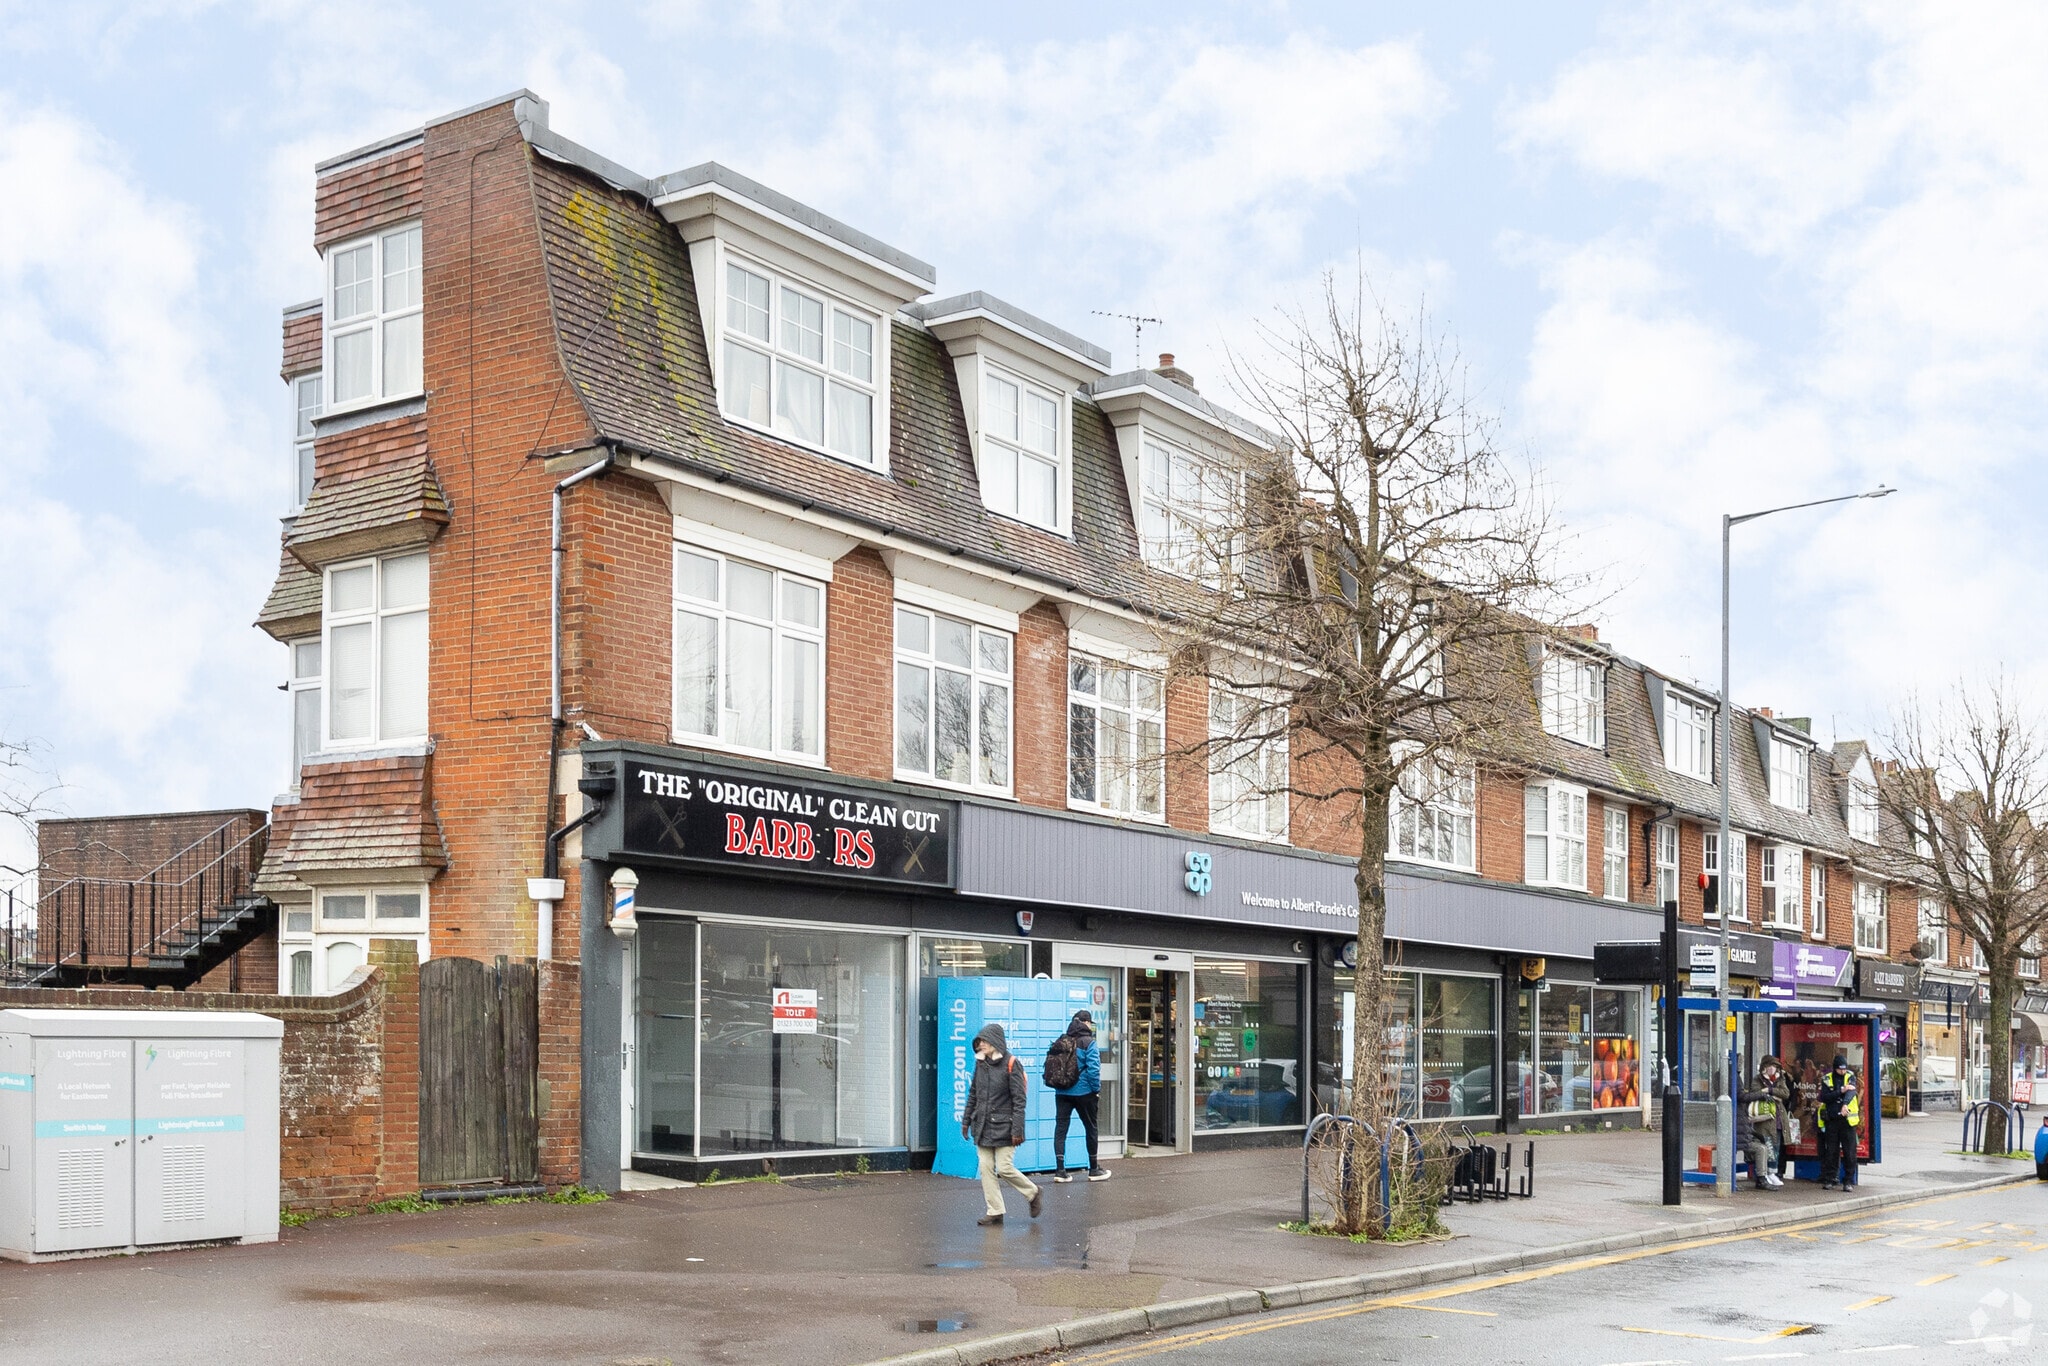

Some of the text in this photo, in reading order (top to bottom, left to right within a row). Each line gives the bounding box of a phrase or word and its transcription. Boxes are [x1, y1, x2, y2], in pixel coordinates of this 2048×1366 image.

[638, 769, 940, 834] THE "ORIGINAL" CLEAN CUT
[725, 813, 876, 869] BARBRS
[1241, 890, 1280, 910] Welcome
[1281, 898, 1290, 910] to
[1291, 897, 1315, 914] Albert
[1315, 900, 1347, 918] Parade's
[1730, 947, 1757, 964] GAMBLE
[785, 1008, 806, 1017] TO LET
[950, 998, 967, 1041] hub
[1816, 1031, 1841, 1039] Intrepid
[57, 1048, 127, 1060] Lightning Fibre
[167, 1047, 232, 1060] Lightning Fibre
[63, 1082, 82, 1090] Local
[82, 1082, 112, 1090] Network
[953, 1045, 967, 1122] amazon
[1793, 1082, 1817, 1090] Make
[60, 1092, 108, 1100] for Eastbourne
[63, 1123, 107, 1132] Switch today
